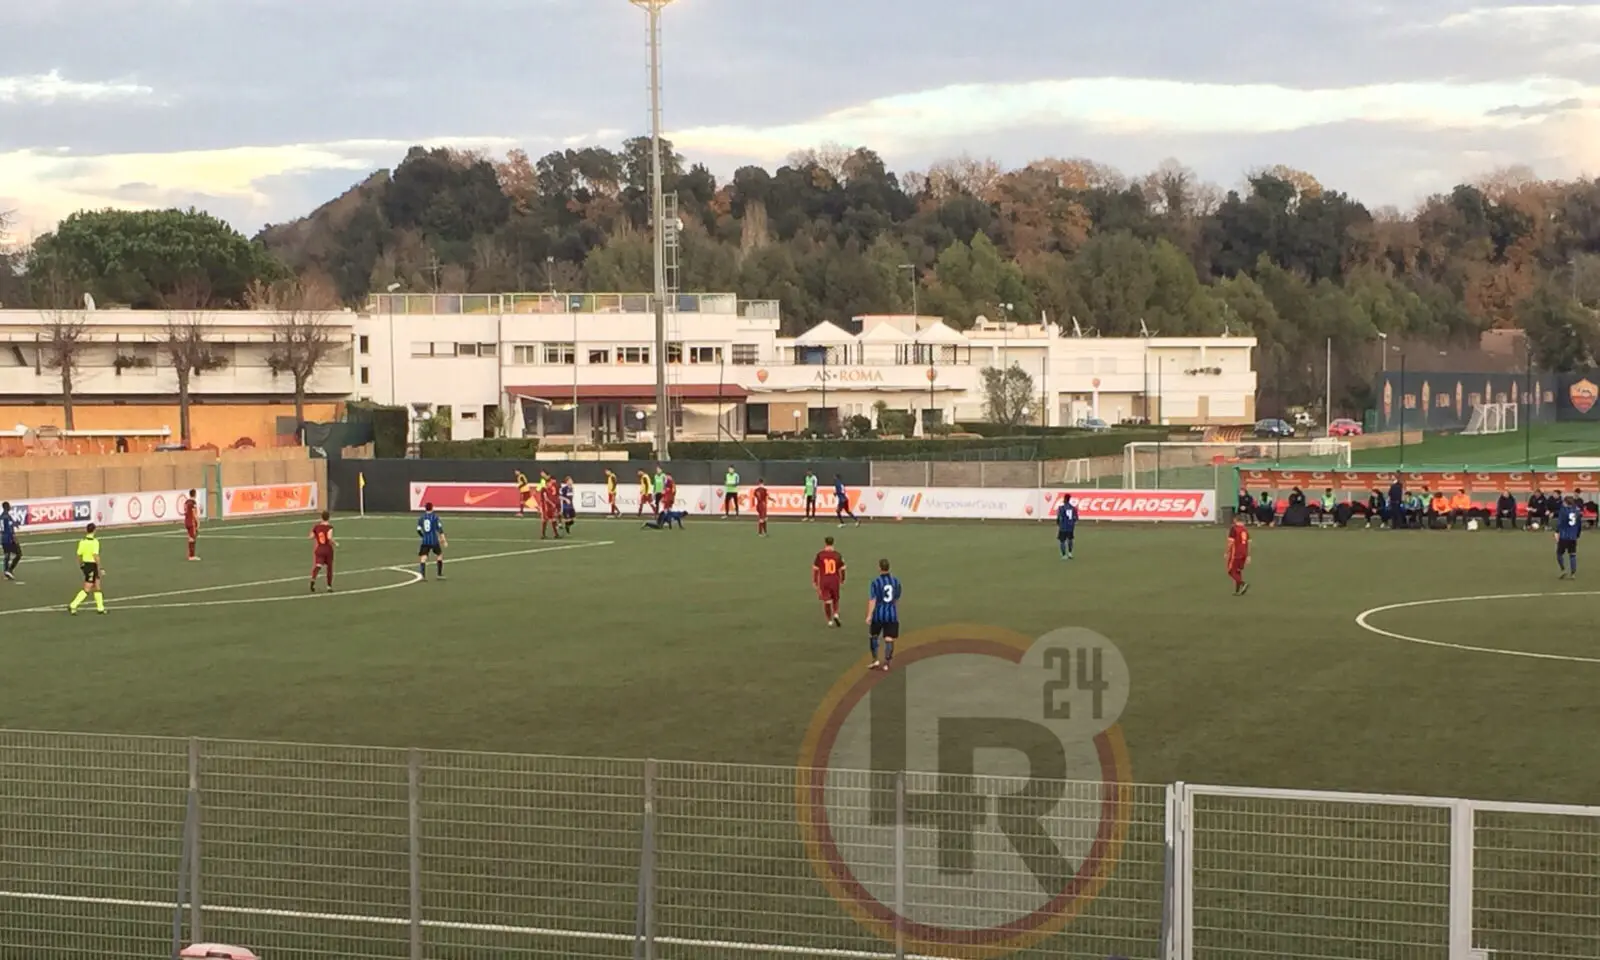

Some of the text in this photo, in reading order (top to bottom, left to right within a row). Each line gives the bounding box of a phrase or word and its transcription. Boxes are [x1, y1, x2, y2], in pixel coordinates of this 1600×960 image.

[839, 369, 884, 382] ROMA
[30, 504, 72, 522] SPORT
[75, 504, 90, 517] HD
[1568, 512, 1576, 526] 5
[823, 558, 836, 575] 10
[883, 584, 894, 603] 3
